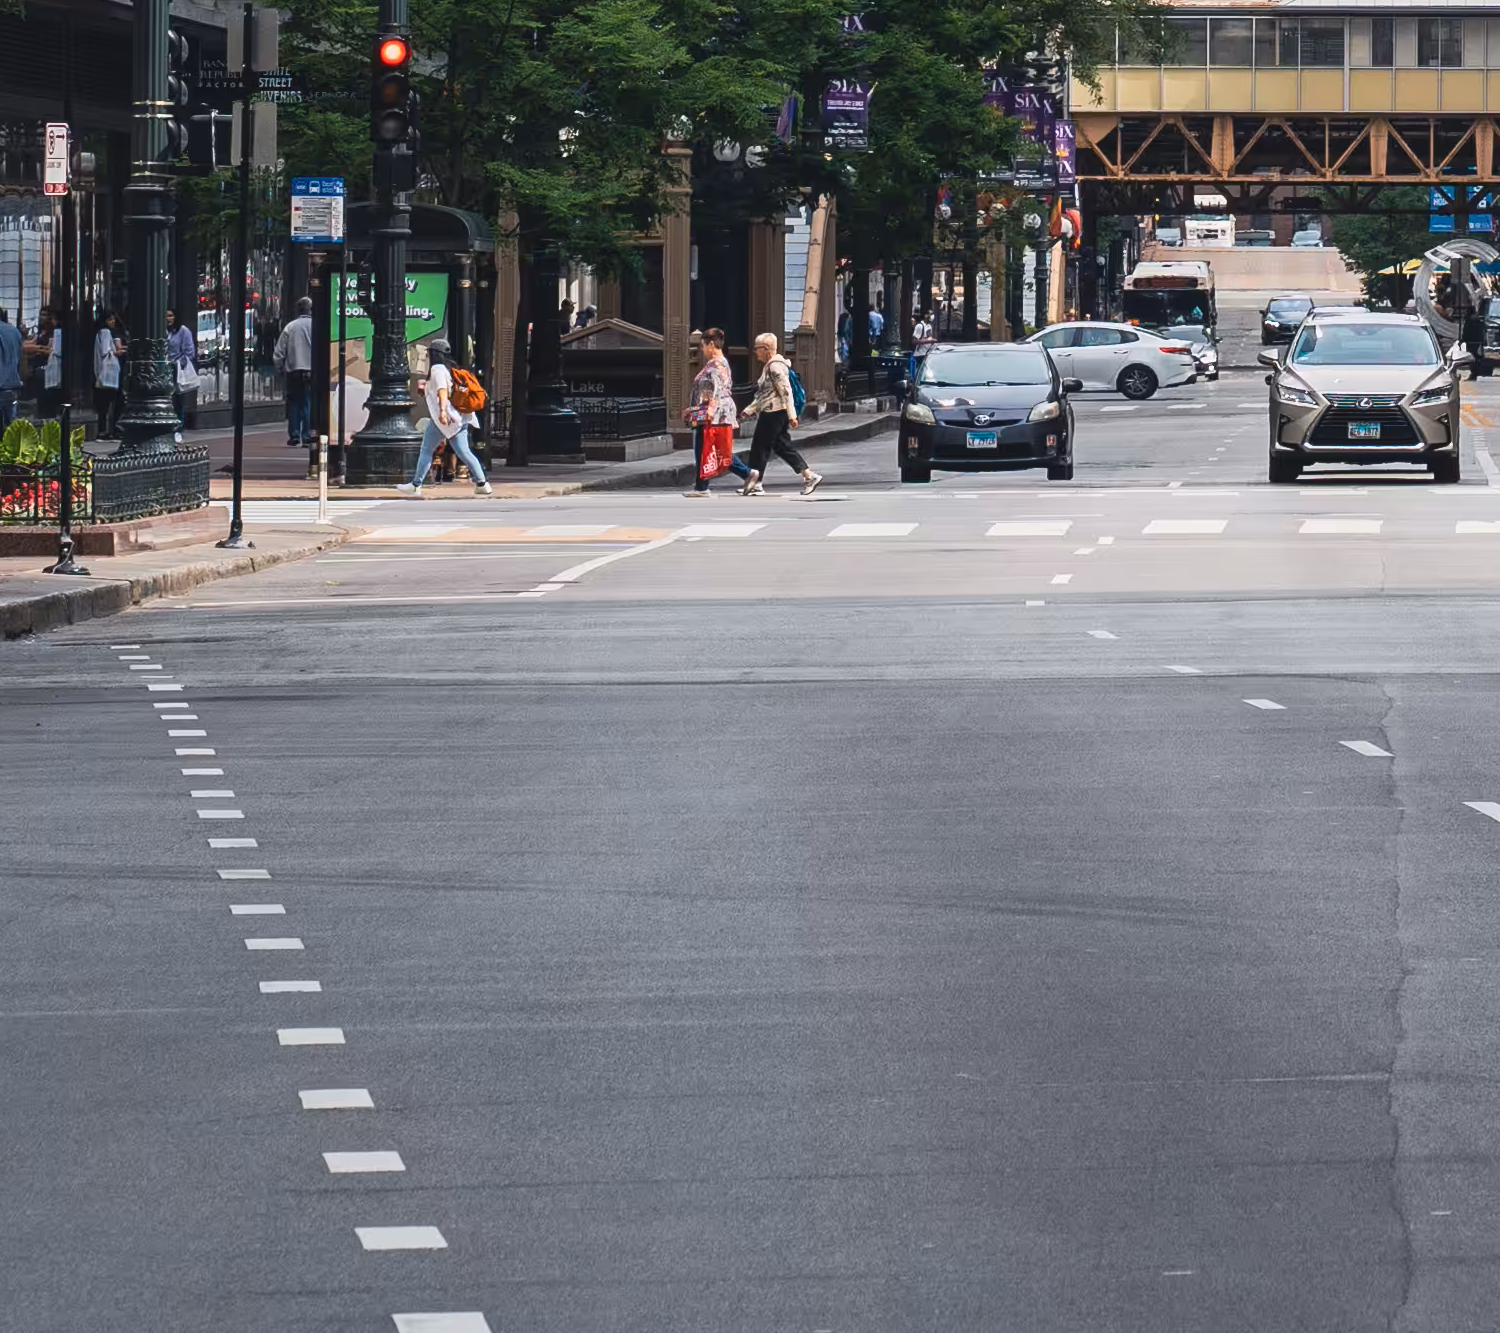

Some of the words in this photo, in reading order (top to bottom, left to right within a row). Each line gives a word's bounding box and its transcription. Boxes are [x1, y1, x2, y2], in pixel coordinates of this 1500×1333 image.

[259, 77, 293, 88] STREET
[1014, 93, 1041, 108] SIX
[570, 381, 605, 393] Lake
